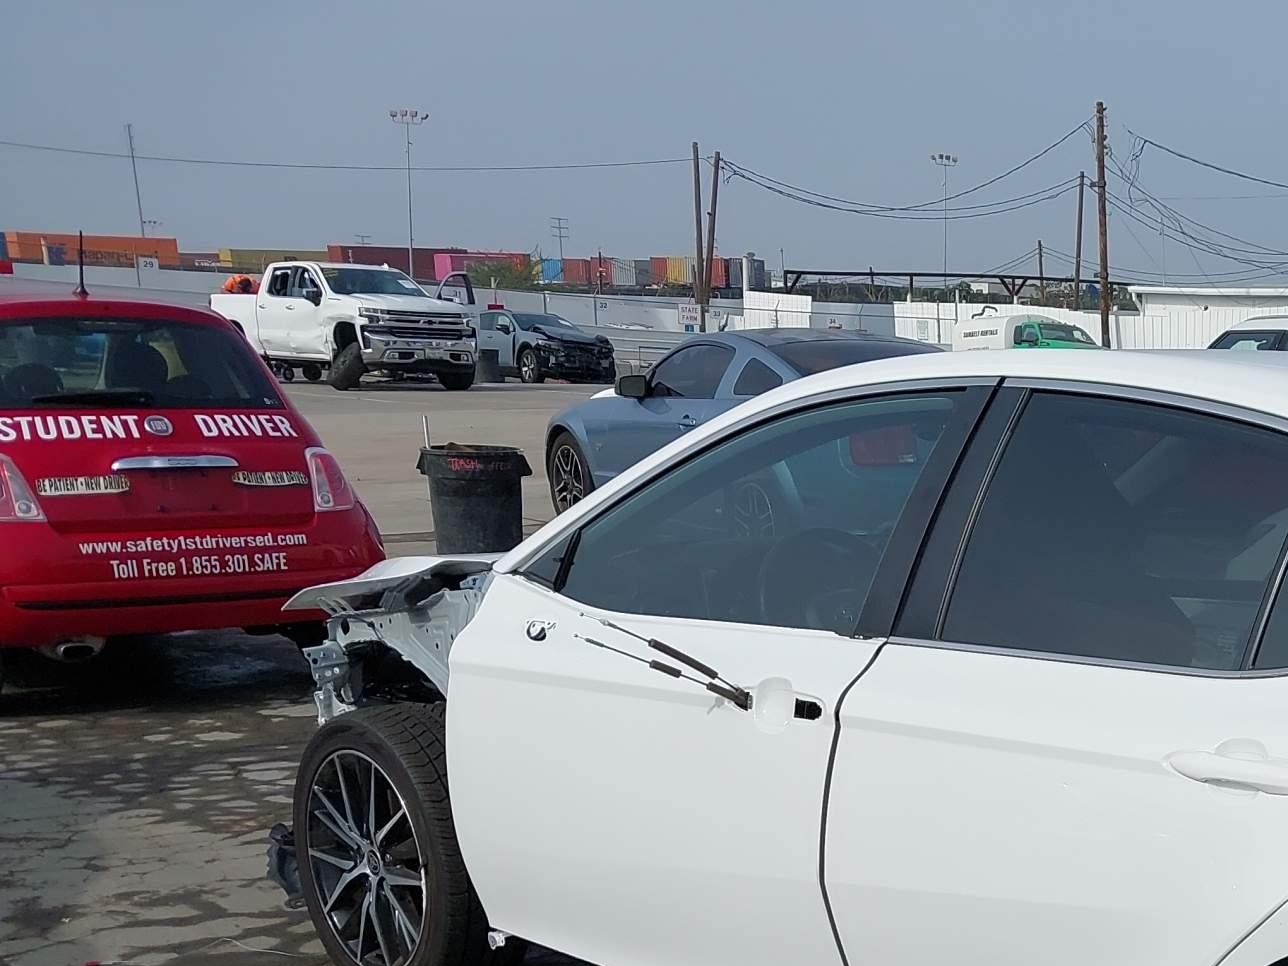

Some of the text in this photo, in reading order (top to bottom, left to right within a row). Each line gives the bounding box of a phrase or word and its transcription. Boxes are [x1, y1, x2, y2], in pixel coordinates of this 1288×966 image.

[143, 260, 154, 268] 29
[681, 306, 699, 314] STATE
[682, 314, 698, 323] FARM
[0, 414, 298, 441] STUDENT DRIVER
[37, 474, 130, 493] BE PATIENT NEW DRIVER
[242, 471, 265, 484] PATIENT
[272, 471, 286, 484] NEW
[79, 532, 307, 554] www.safety1stdriversed.com
[110, 552, 289, 579] Toll Free 1.855.301.SAFE
